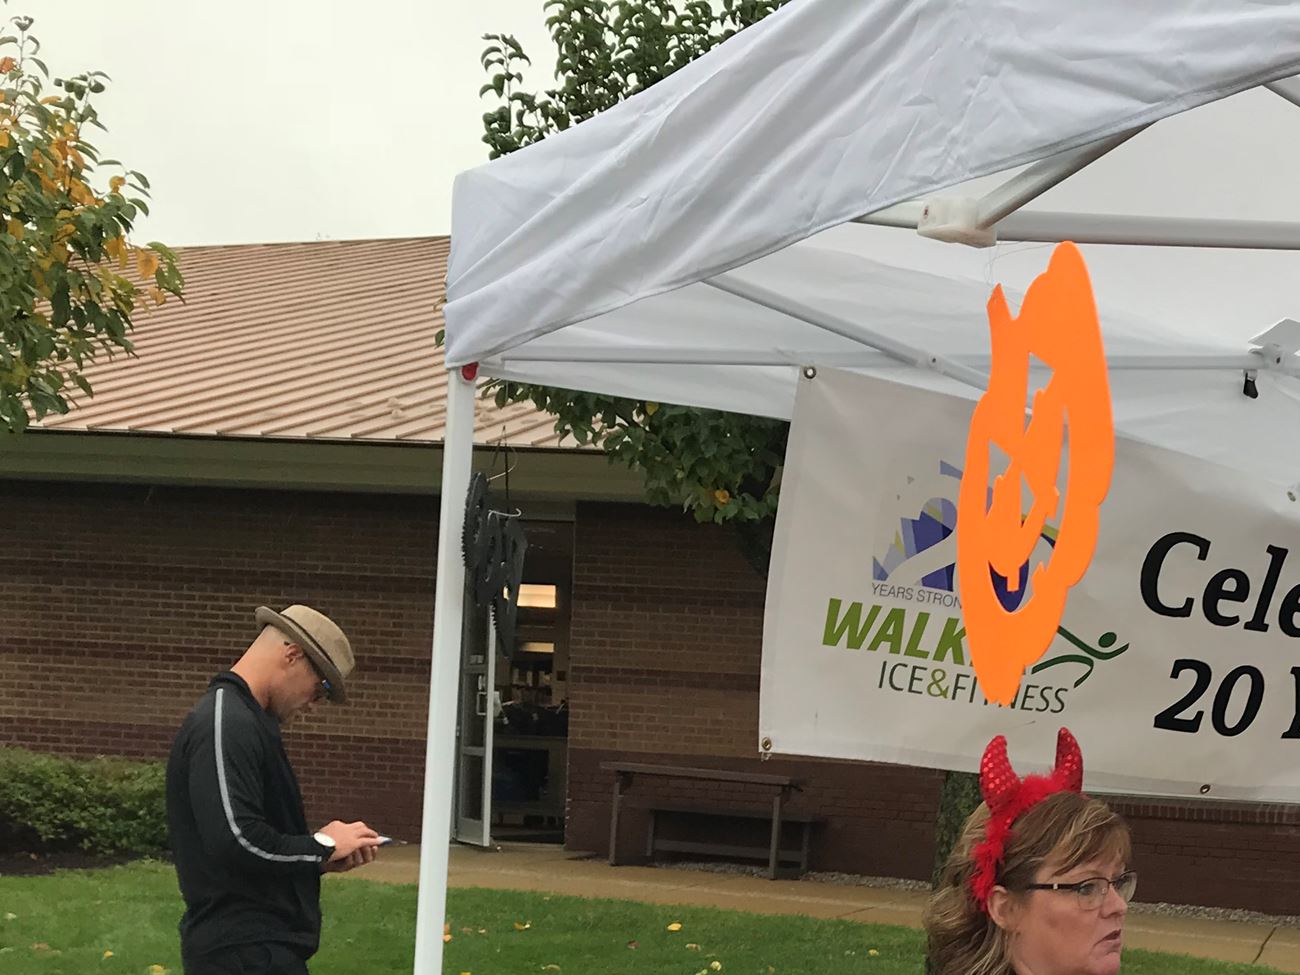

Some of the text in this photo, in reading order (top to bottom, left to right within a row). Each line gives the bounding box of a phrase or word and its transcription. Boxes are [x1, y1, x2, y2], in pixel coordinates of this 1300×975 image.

[872, 582, 964, 609] YEARS STRON
[822, 597, 974, 668] WALK
[1153, 658, 1265, 736] 20
